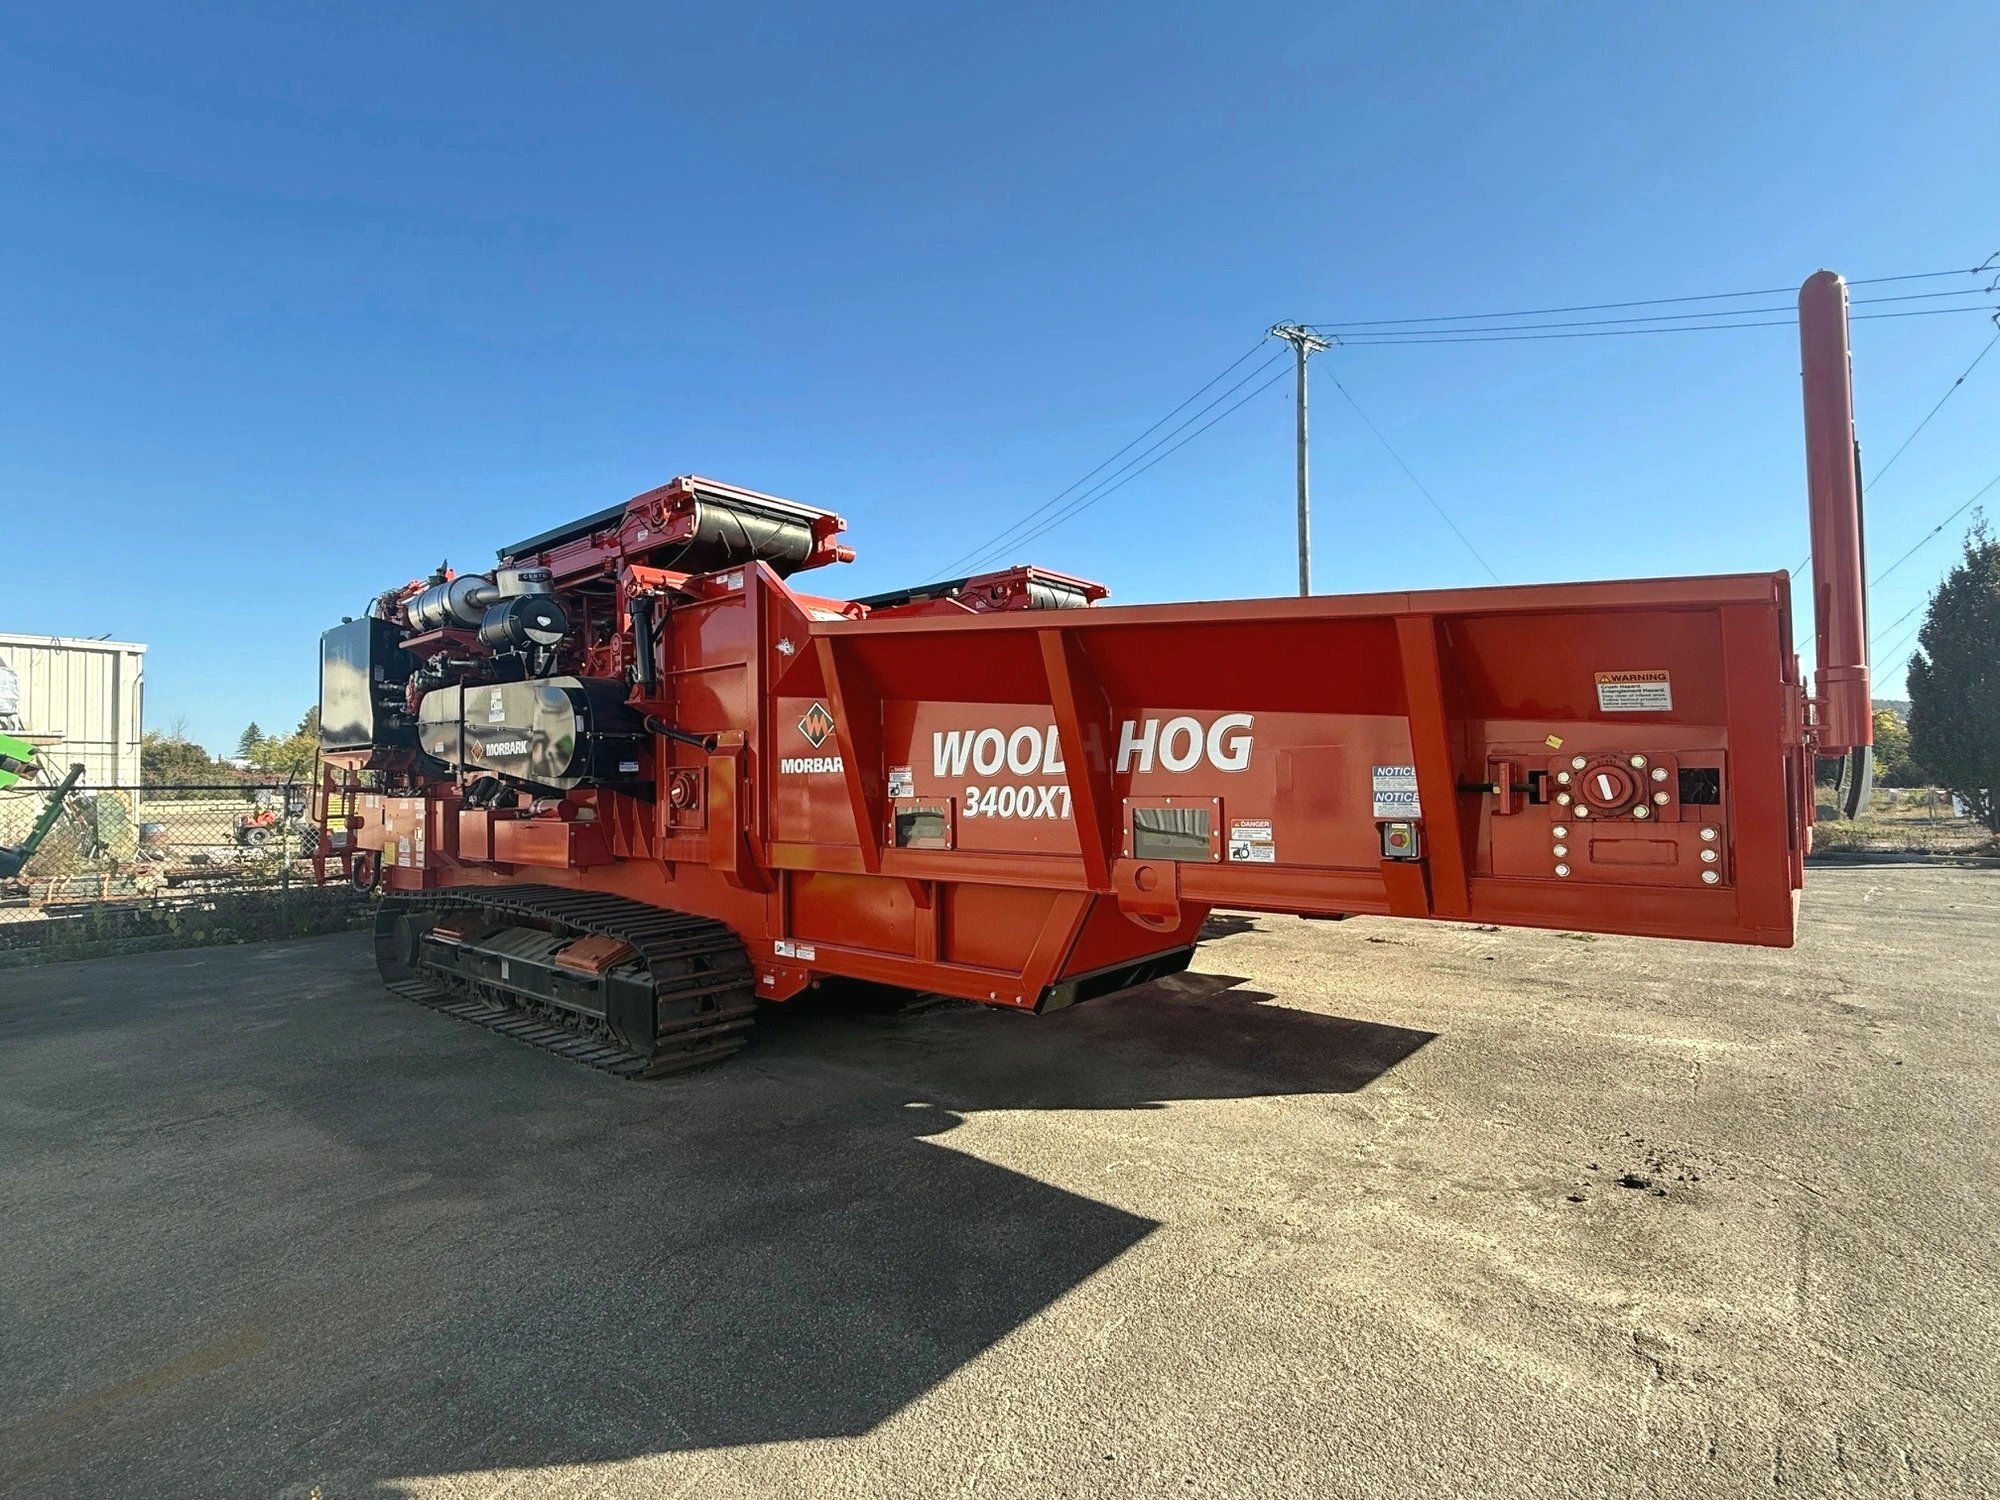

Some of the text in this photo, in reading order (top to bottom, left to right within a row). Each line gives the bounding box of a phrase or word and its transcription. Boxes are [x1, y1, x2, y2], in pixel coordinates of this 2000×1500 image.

[1611, 673, 1666, 681] WARNING
[486, 740, 528, 757] MORBARK
[1115, 713, 1255, 774] HOG
[781, 757, 844, 774] MORBAR
[962, 785, 1072, 820] 3400XT
[1375, 792, 1420, 802] NOTICE
